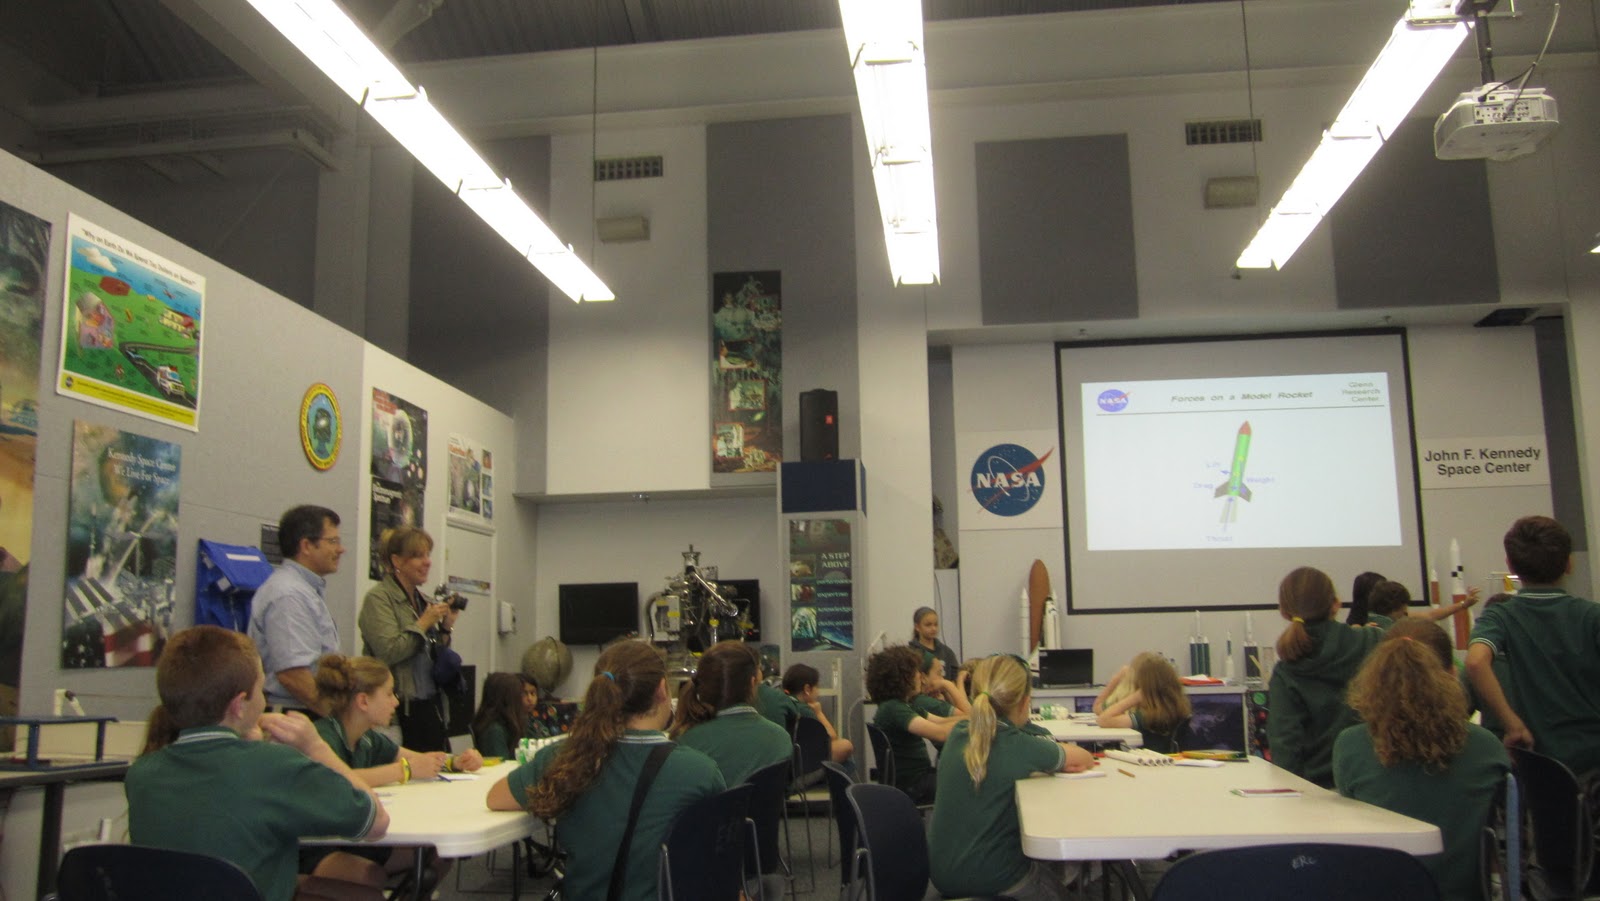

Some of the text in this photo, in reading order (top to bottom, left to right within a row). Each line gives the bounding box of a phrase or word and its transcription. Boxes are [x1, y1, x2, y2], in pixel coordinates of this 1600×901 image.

[1278, 391, 1314, 399] Rocket
[108, 446, 177, 472] Kennedy Space Center
[1424, 446, 1541, 462] John F. Kennedy
[113, 464, 126, 476] We
[126, 466, 141, 479] Live
[152, 472, 170, 486] Space
[1437, 461, 1532, 477] Space Center
[976, 471, 1042, 489] NASA
[1193, 482, 1214, 490] Drag
[821, 552, 850, 560] A STEP
[822, 561, 850, 569] ABOVE
[817, 591, 849, 599] expertise
